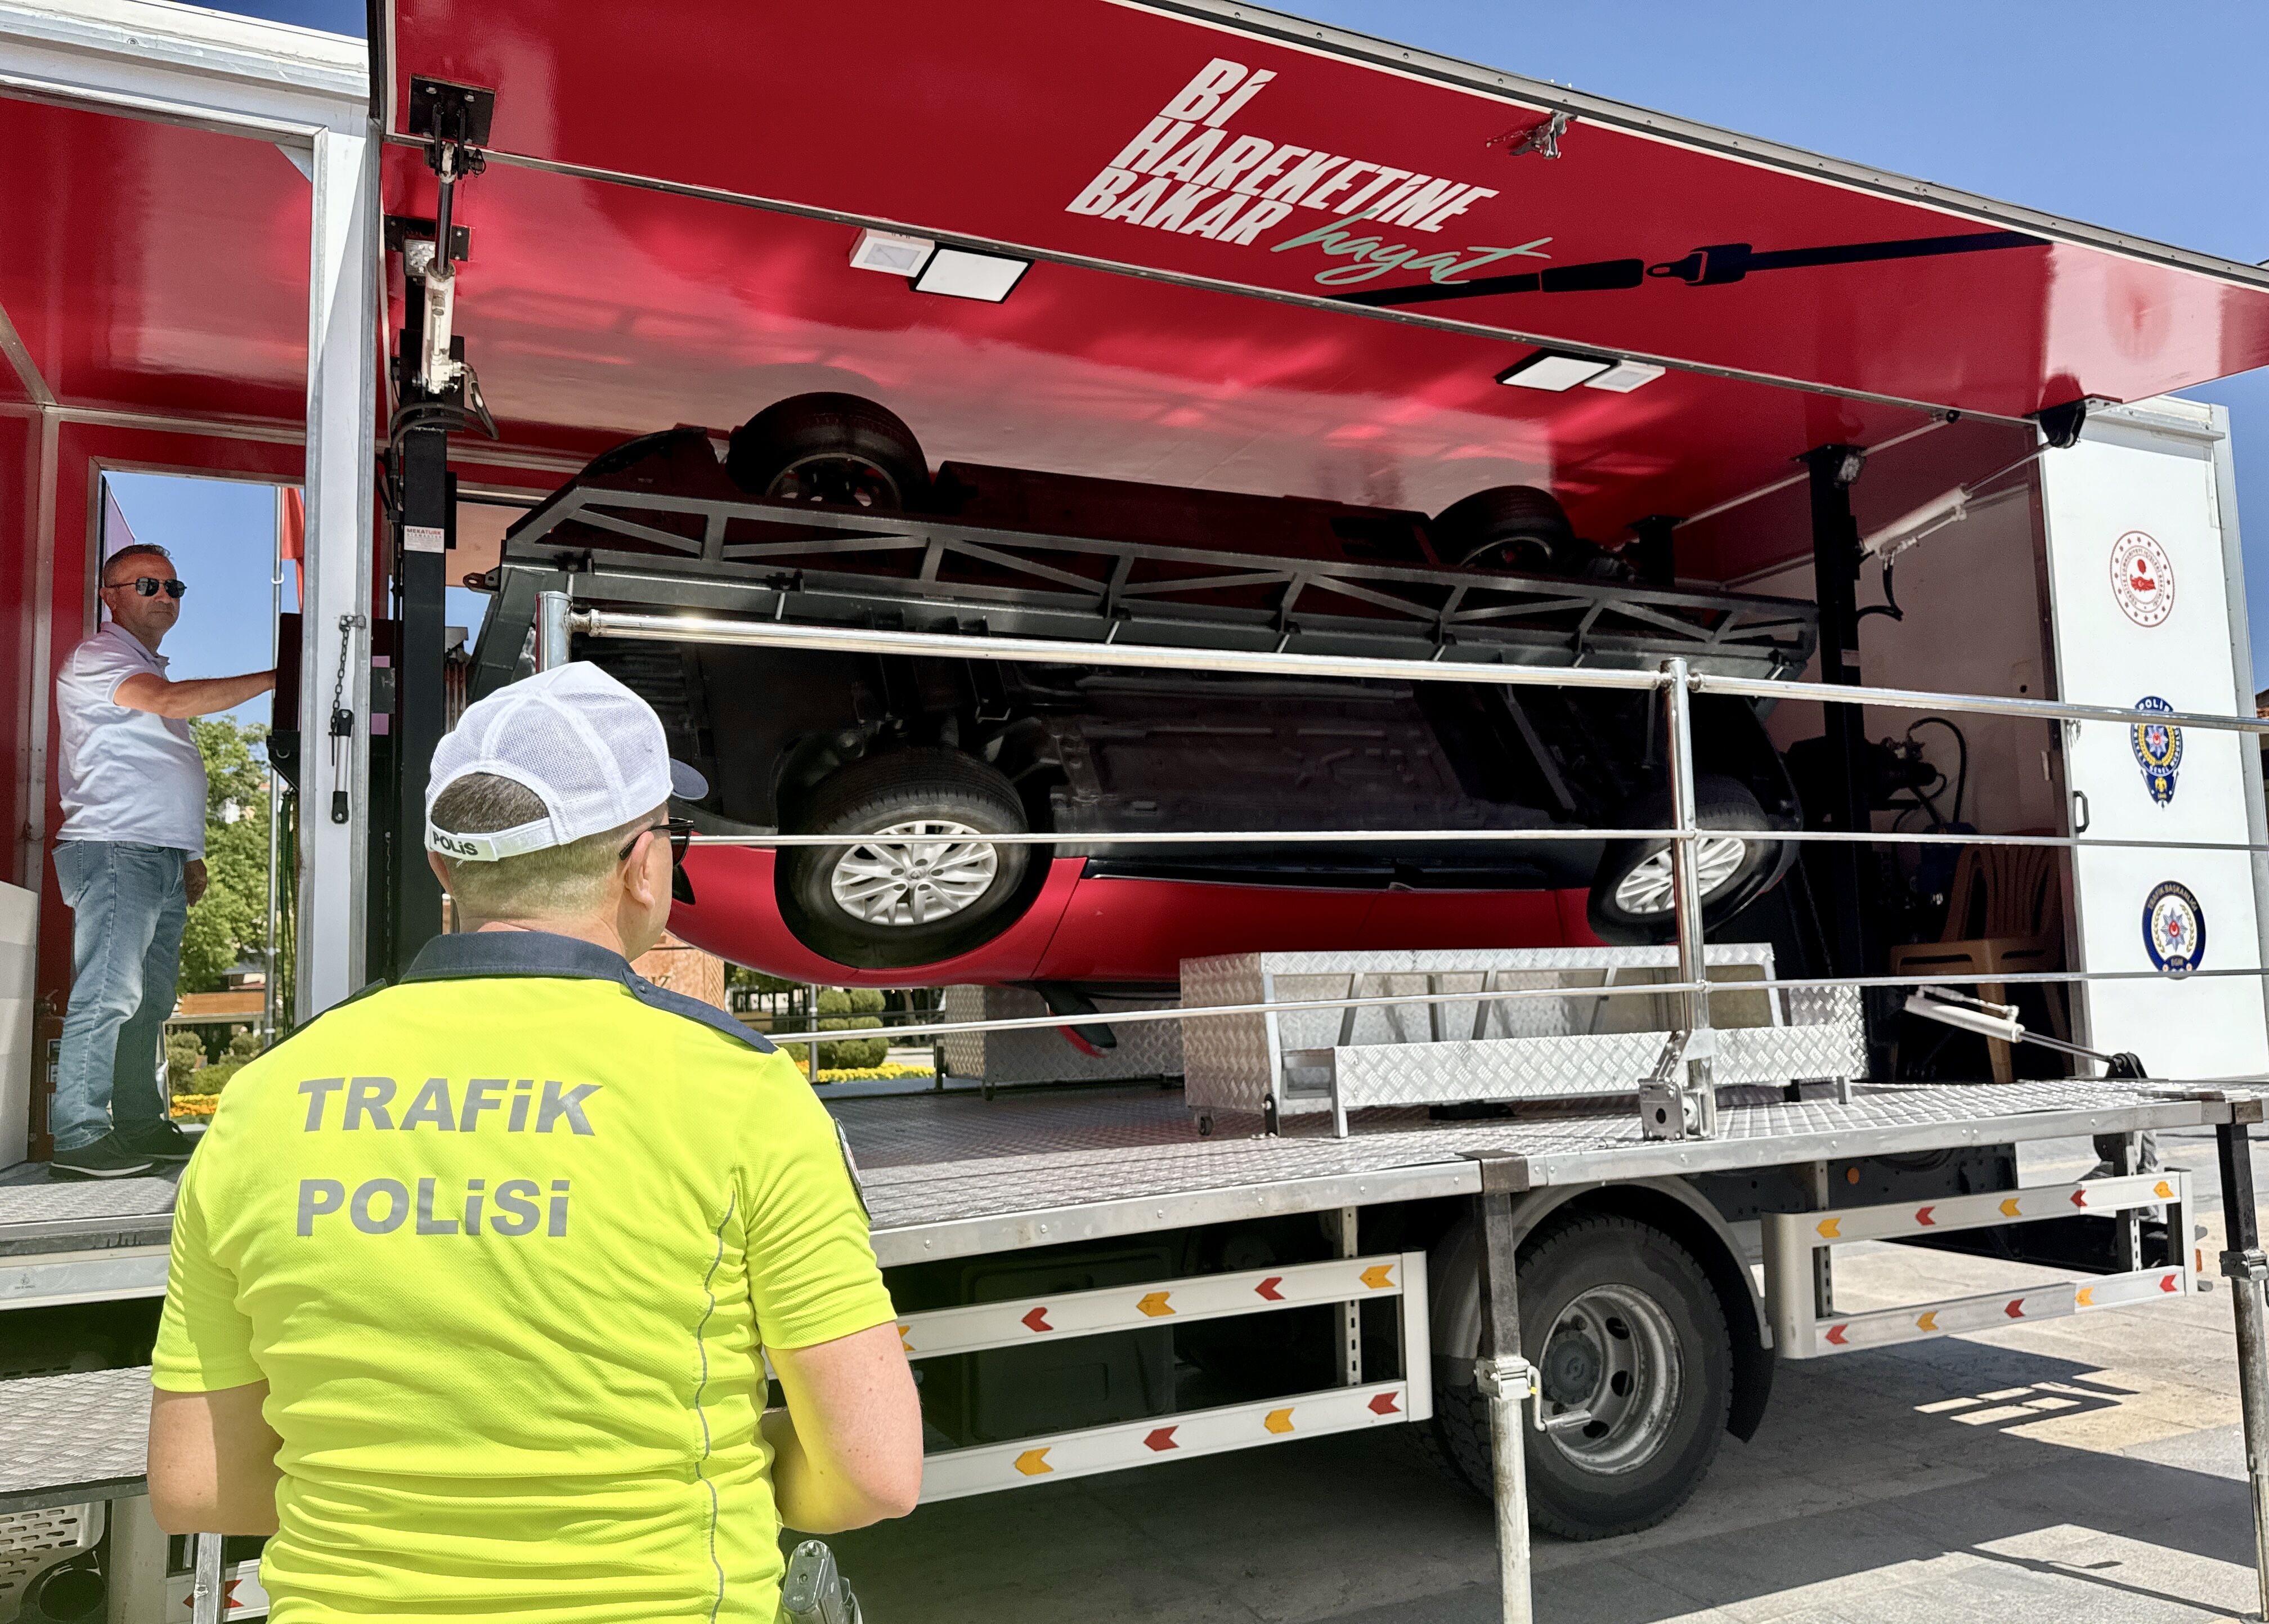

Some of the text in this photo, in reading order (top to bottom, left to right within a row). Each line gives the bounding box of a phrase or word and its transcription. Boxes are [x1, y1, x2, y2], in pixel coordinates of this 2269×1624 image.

[1064, 167, 1294, 246] BAKAR
[1110, 116, 1500, 233] HAREKETİNE
[1270, 207, 1553, 285] hayat
